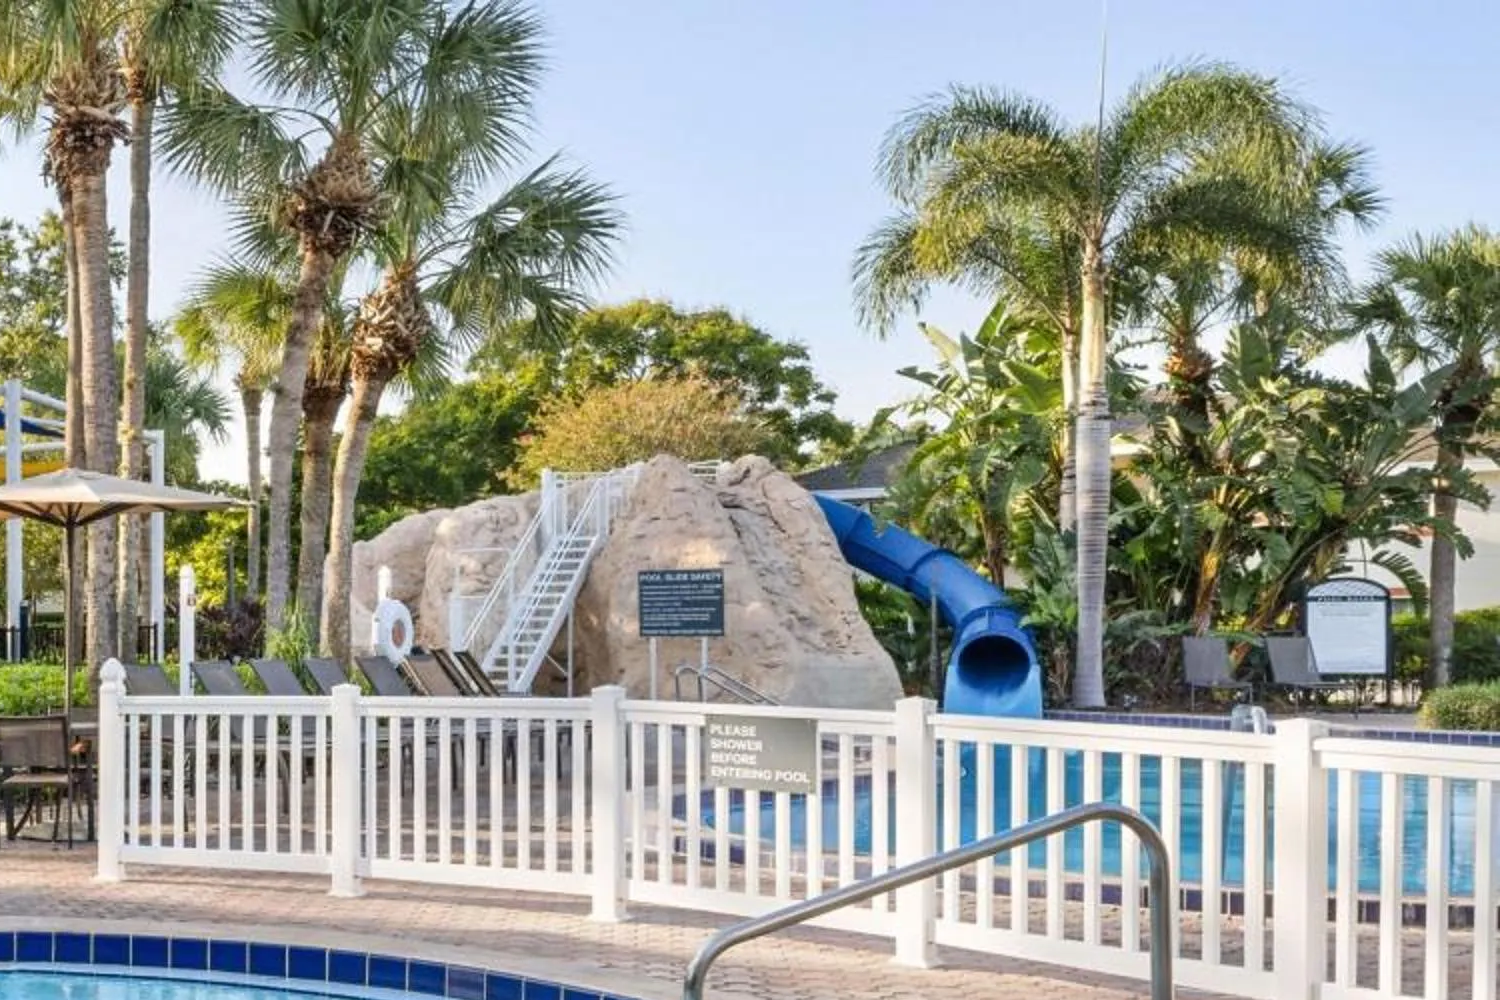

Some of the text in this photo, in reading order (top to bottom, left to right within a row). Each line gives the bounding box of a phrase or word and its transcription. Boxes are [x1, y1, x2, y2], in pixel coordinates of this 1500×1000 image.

[710, 724, 756, 736] PLEASE
[711, 739, 762, 752] SHOWER
[711, 753, 756, 765] BEFORE
[711, 766, 810, 782] ENTERING POOL
